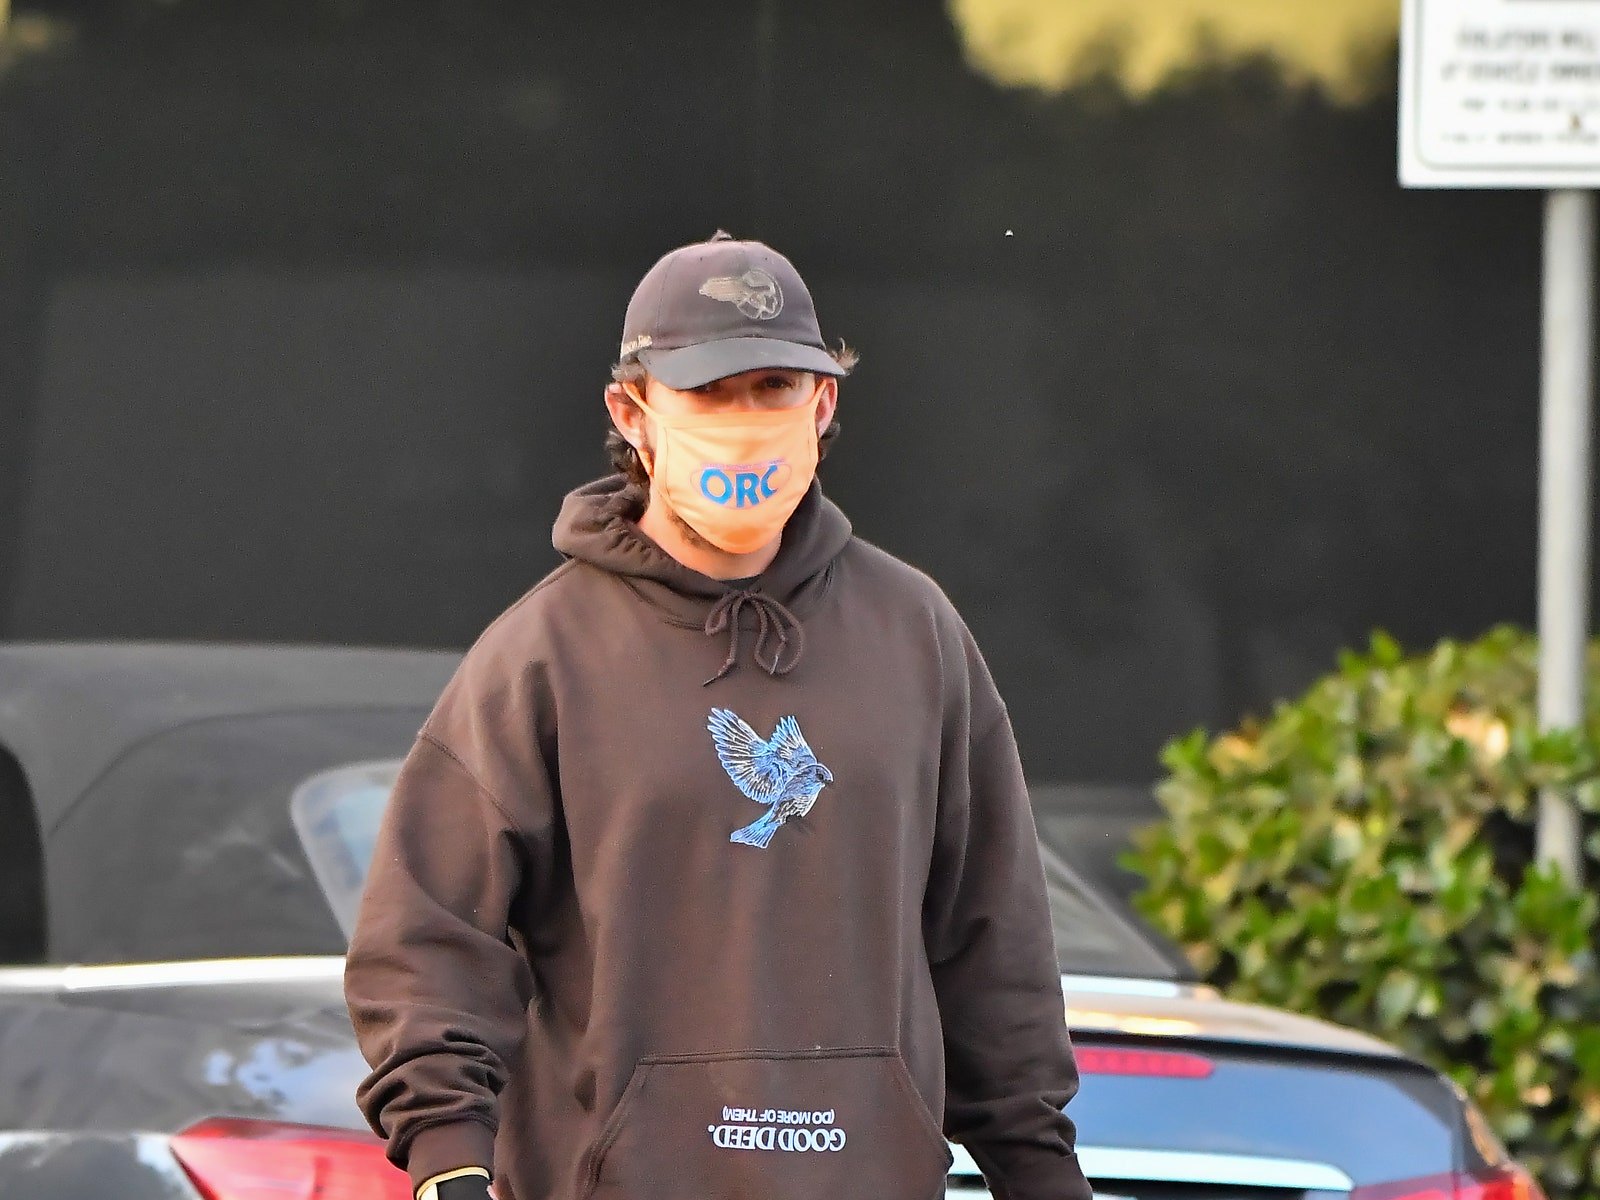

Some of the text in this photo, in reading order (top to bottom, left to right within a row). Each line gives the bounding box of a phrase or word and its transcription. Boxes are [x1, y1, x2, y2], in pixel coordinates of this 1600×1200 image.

[699, 463, 779, 508] ORC
[722, 1105, 835, 1125] (DO MORE OF THEM)
[707, 1124, 847, 1152] GOOD DEED.
